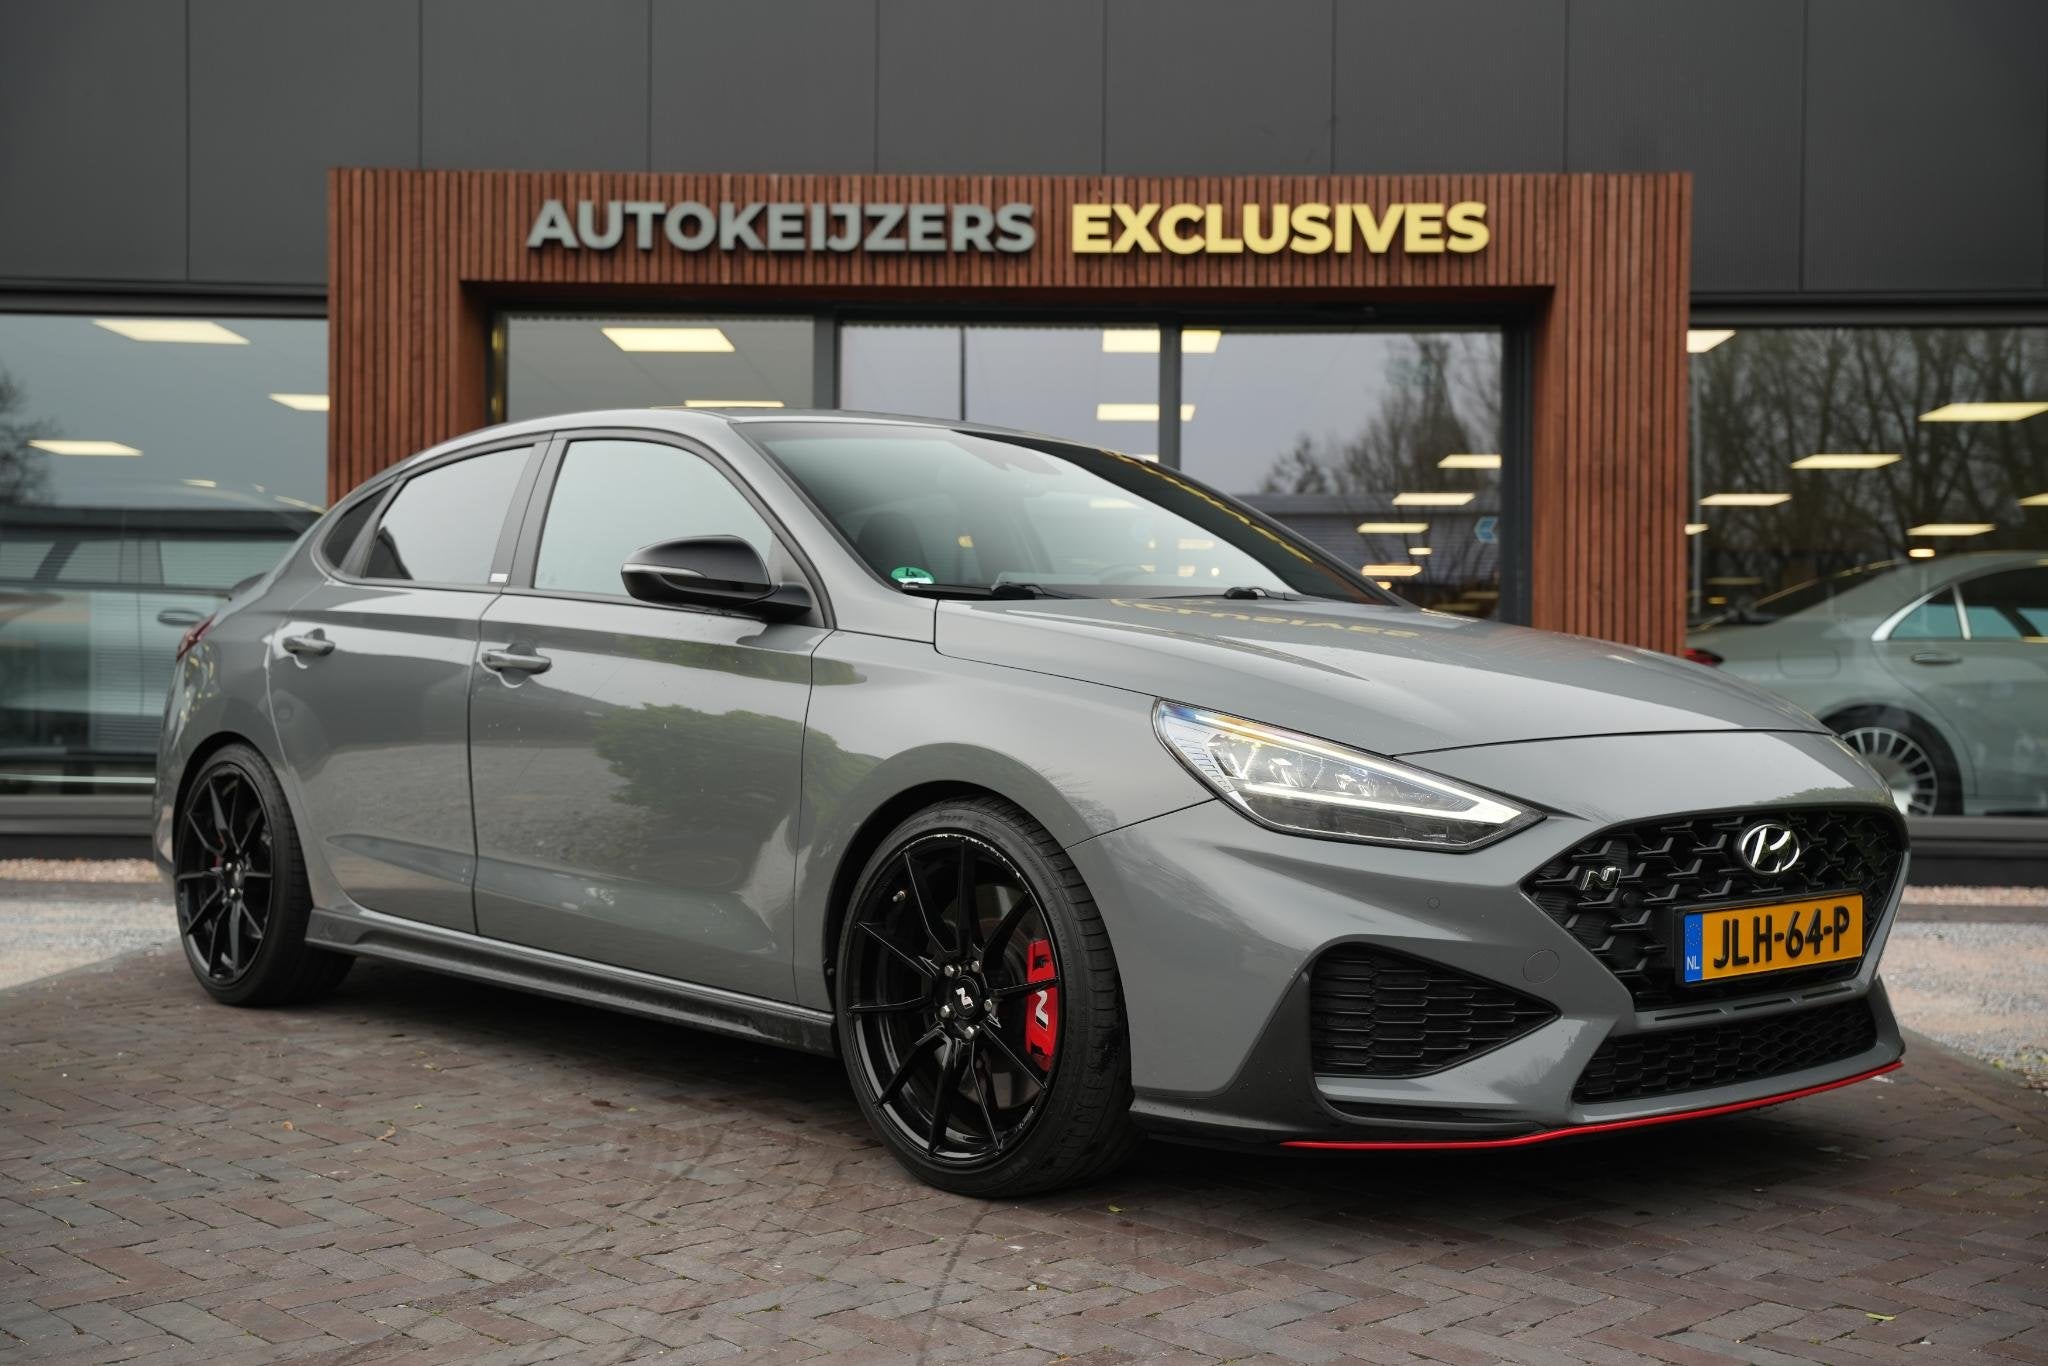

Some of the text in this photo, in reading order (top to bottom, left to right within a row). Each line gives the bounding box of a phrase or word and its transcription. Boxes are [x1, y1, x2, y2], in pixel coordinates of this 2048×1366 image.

[526, 200, 1490, 254] AUTOKEIJZERS EXCLUSIVES
[1686, 954, 1701, 971] NL
[1713, 905, 1850, 968] JLH-64-P
